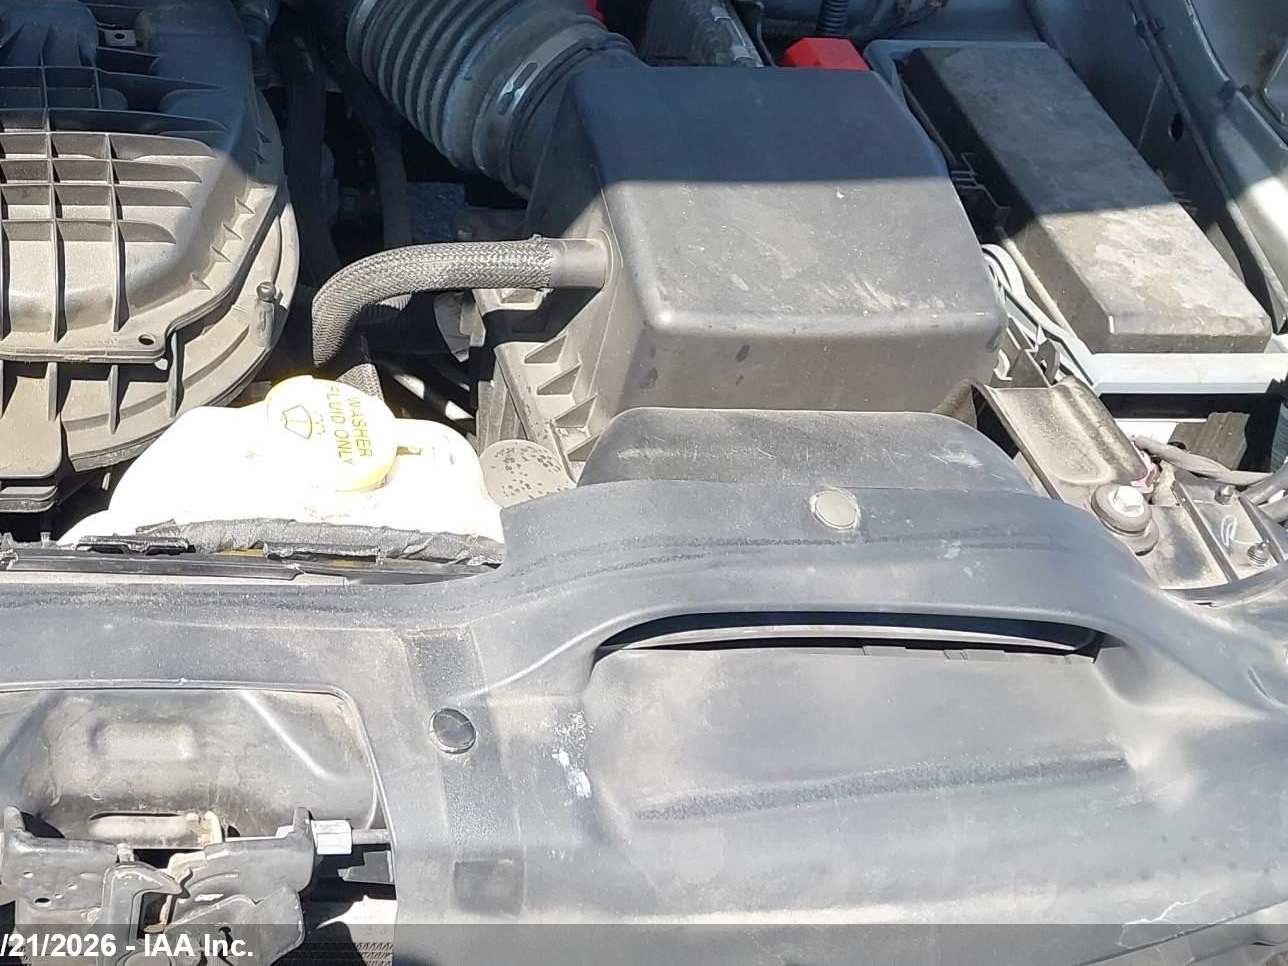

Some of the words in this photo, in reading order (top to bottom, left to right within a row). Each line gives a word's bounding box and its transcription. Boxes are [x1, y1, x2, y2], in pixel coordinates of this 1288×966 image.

[326, 385, 346, 425] FLUID
[346, 396, 373, 458] WASHER
[334, 429, 356, 466] ONLY
